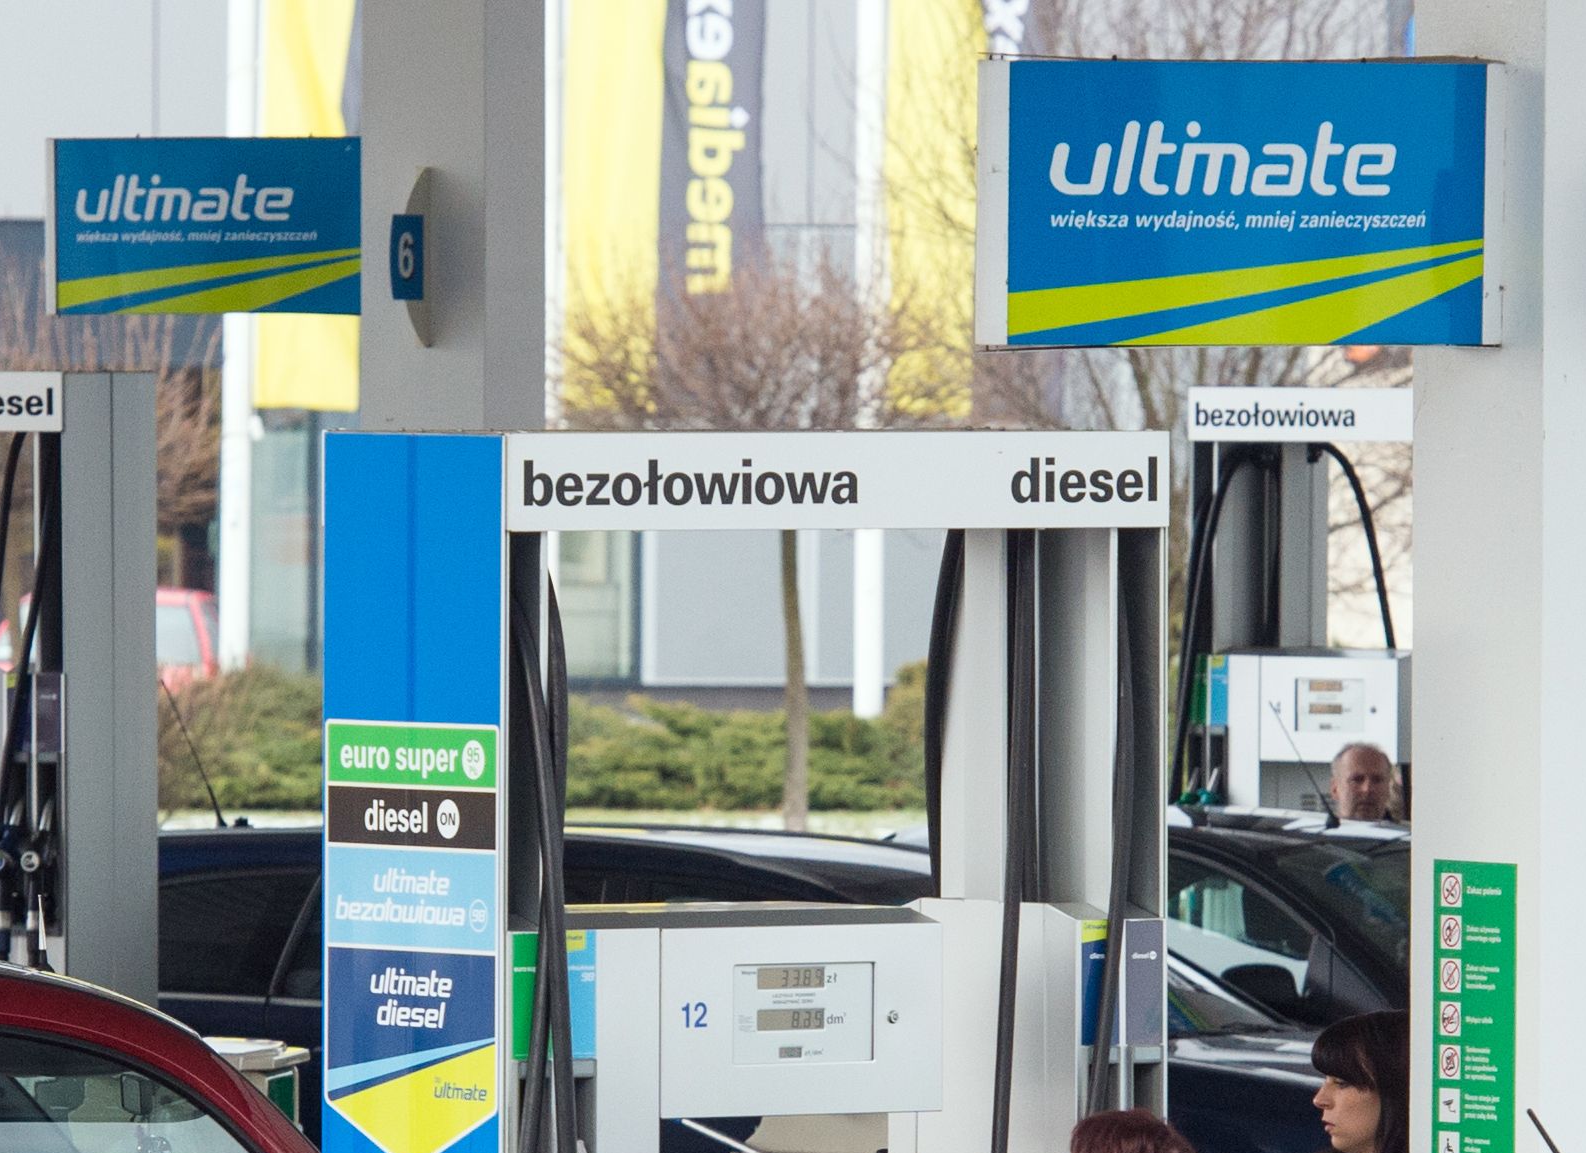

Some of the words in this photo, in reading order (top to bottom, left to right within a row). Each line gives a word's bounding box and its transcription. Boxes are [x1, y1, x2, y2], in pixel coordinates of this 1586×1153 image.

[1049, 120, 1397, 196] ultimate
[75, 174, 294, 222] ultimate
[1050, 210, 1128, 230] większa
[1135, 210, 1239, 231] wydajność,
[1245, 210, 1295, 231] mniej
[1300, 209, 1426, 231] zanieczyszczeń
[398, 232, 414, 278] 6
[1195, 402, 1355, 427] bezołowiowa
[523, 458, 859, 507] bezołowiowa
[1011, 456, 1158, 504] diesel
[340, 744, 390, 770] euro
[395, 746, 458, 779] super
[466, 747, 480, 763] 95
[364, 799, 428, 834] diesel
[440, 812, 456, 826] ON
[373, 868, 450, 895] ultimate
[335, 895, 465, 926] bezołowiowa
[370, 967, 452, 998] ultimate
[376, 999, 446, 1029] diesel
[681, 1002, 708, 1028] 12
[434, 1081, 487, 1102] ultimate
